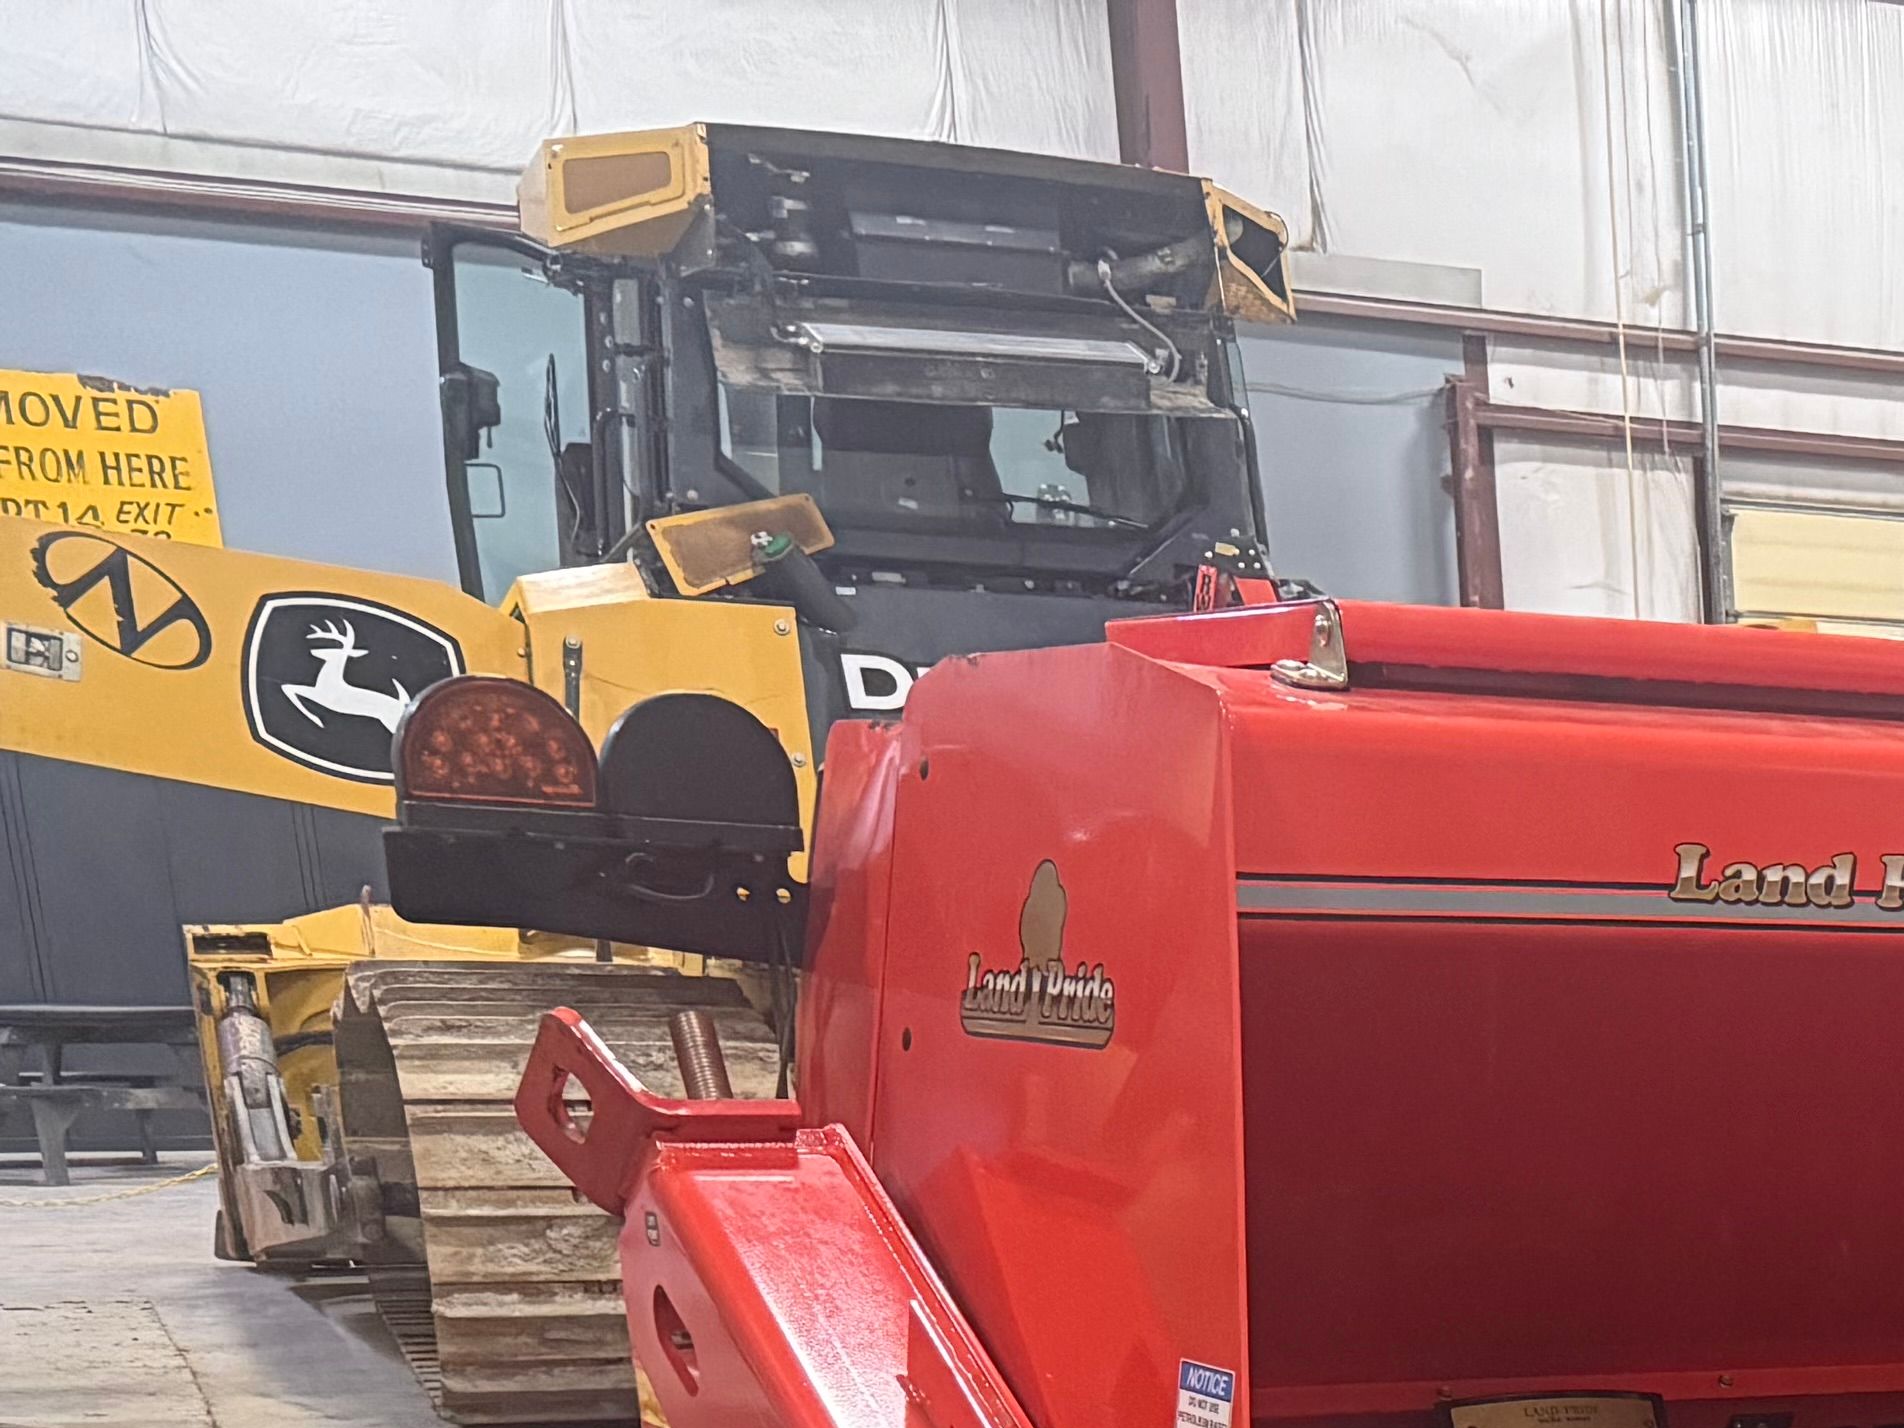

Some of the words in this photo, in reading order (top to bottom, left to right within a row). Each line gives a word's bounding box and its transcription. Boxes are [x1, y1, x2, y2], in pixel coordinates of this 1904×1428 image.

[98, 451, 192, 491] HERE
[116, 500, 185, 525] EXIT
[1667, 842, 1858, 909] Land
[964, 952, 1030, 1016] Land
[1040, 959, 1115, 1025] Pride
[1186, 1367, 1229, 1396] NOTICE
